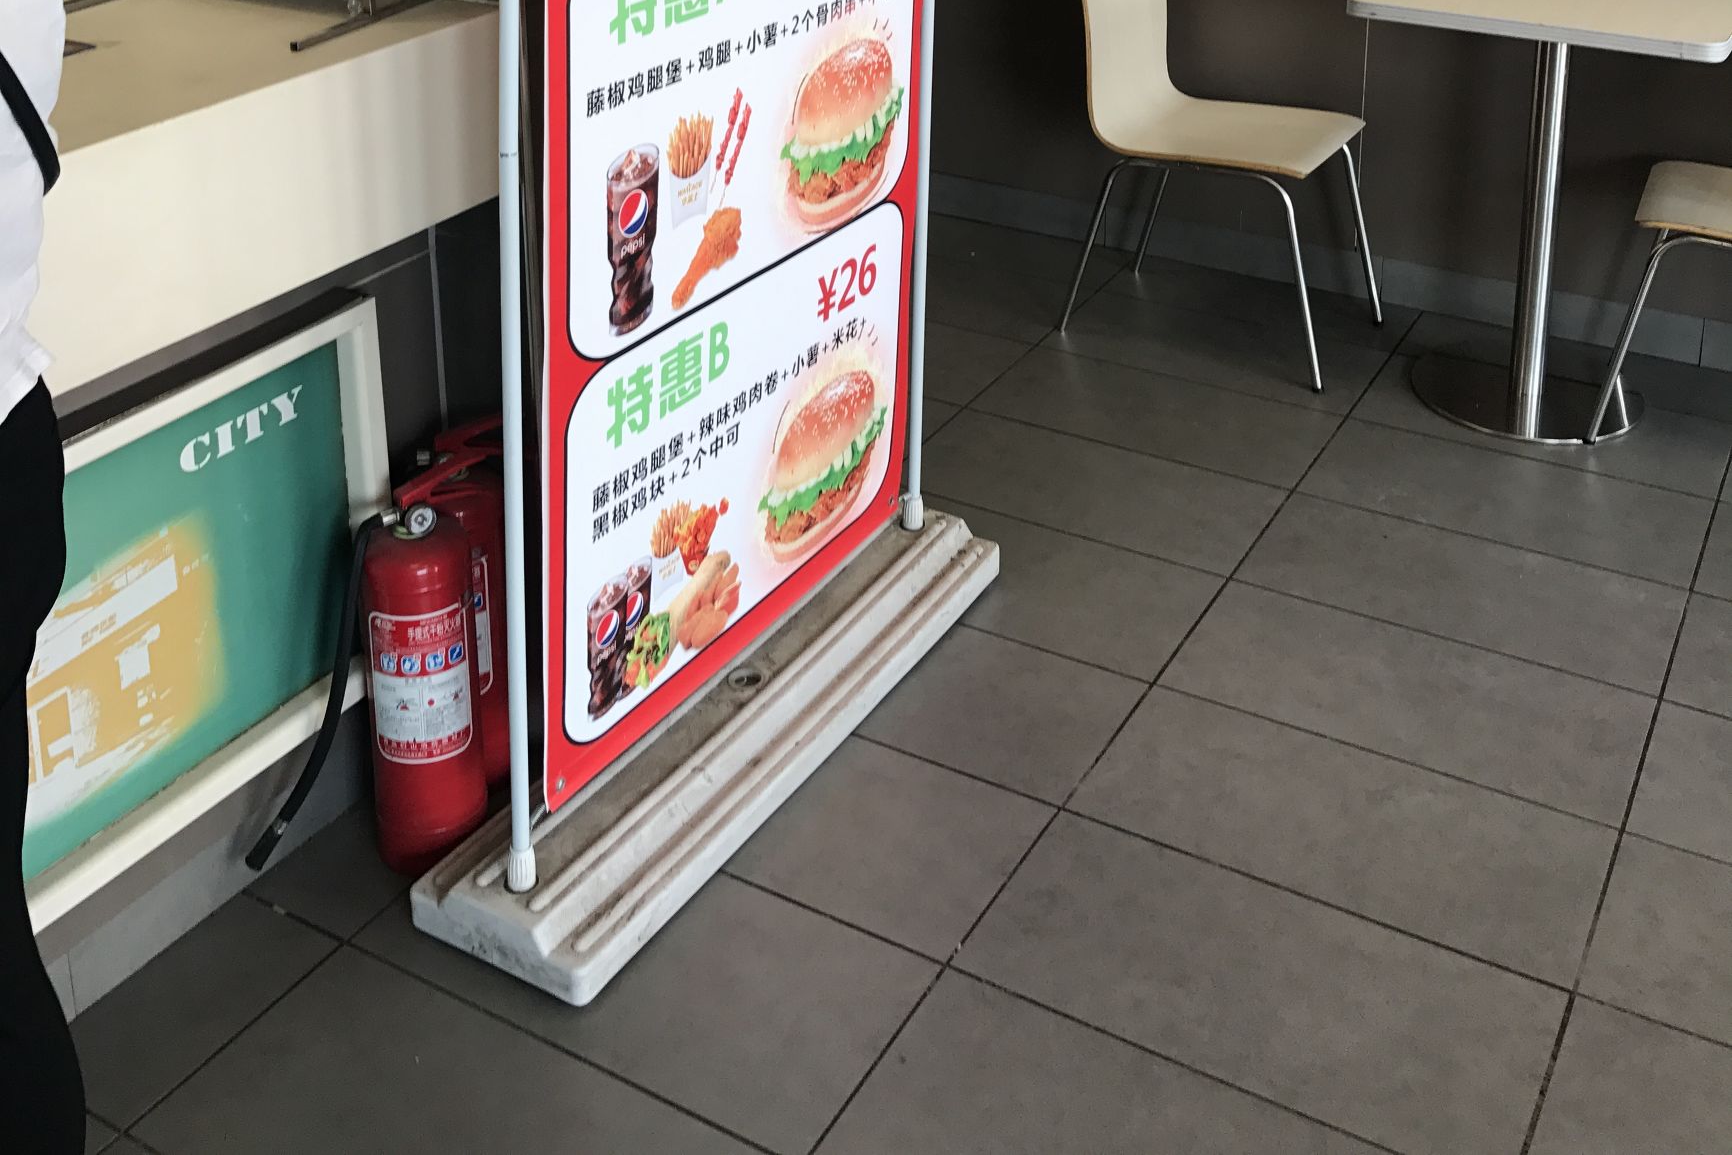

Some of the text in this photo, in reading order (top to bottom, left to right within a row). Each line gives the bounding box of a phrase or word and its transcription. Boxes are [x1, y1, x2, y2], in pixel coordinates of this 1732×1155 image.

[620, 232, 646, 260] pepsi
[816, 243, 878, 323] ¥26
[178, 384, 304, 473] CITY
[606, 320, 731, 450] 特惠B
[592, 420, 742, 544] 黑椒鸡块+2个中可
